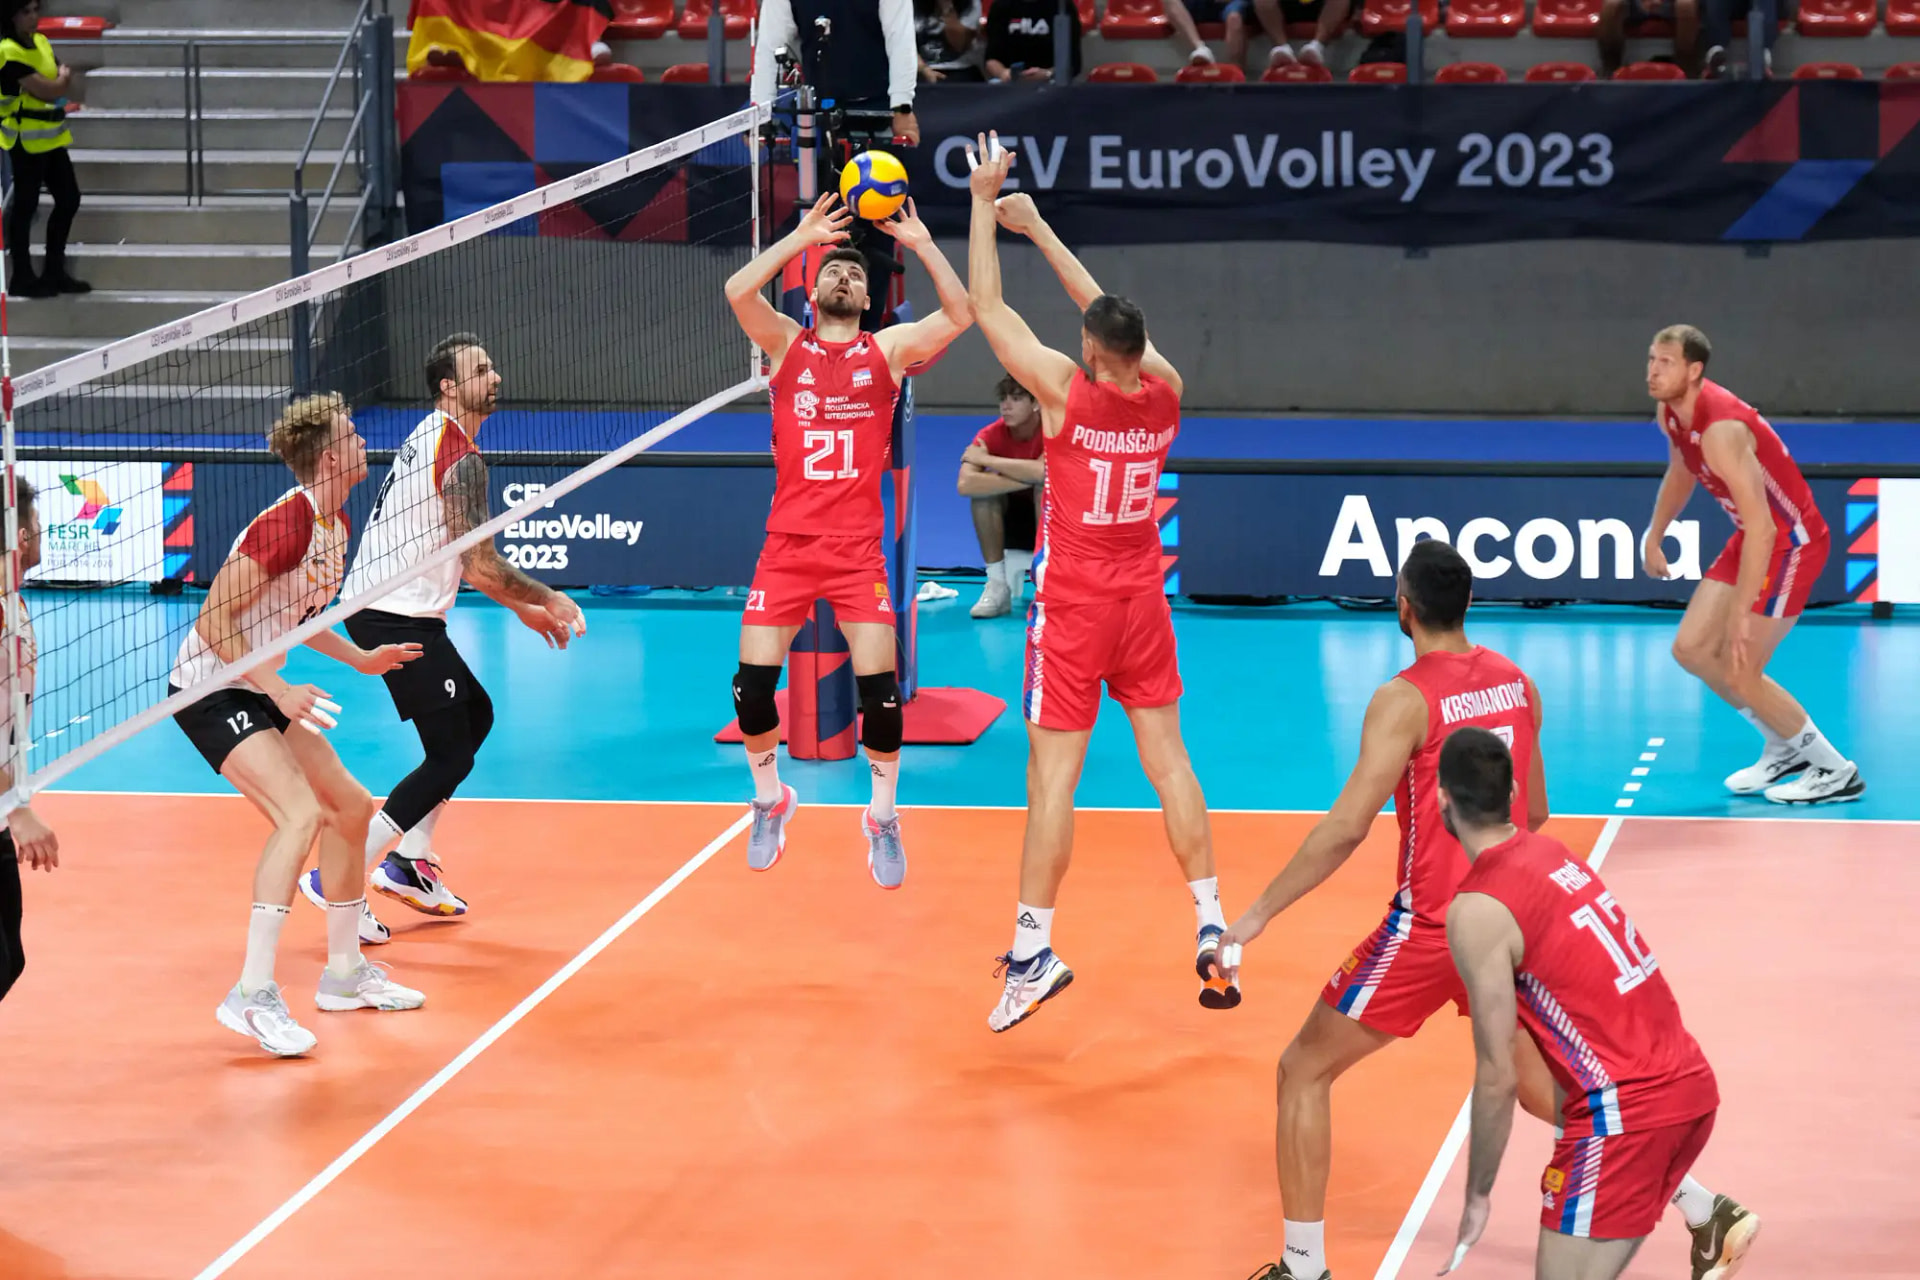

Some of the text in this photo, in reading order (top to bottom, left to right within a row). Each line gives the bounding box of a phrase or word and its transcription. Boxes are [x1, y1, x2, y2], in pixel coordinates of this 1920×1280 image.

[1008, 17, 1049, 35] FILA
[1090, 131, 1436, 202] EuroVolley
[1457, 132, 1614, 187] 2023
[803, 430, 859, 480] 21
[1082, 457, 1159, 525] 18
[48, 524, 90, 539] FESR
[504, 513, 643, 545] EuroVolley
[1317, 494, 1703, 580] Ancona
[503, 544, 569, 570] 2023
[746, 590, 766, 611] 21
[444, 678, 456, 699] 9
[226, 710, 255, 735] 12
